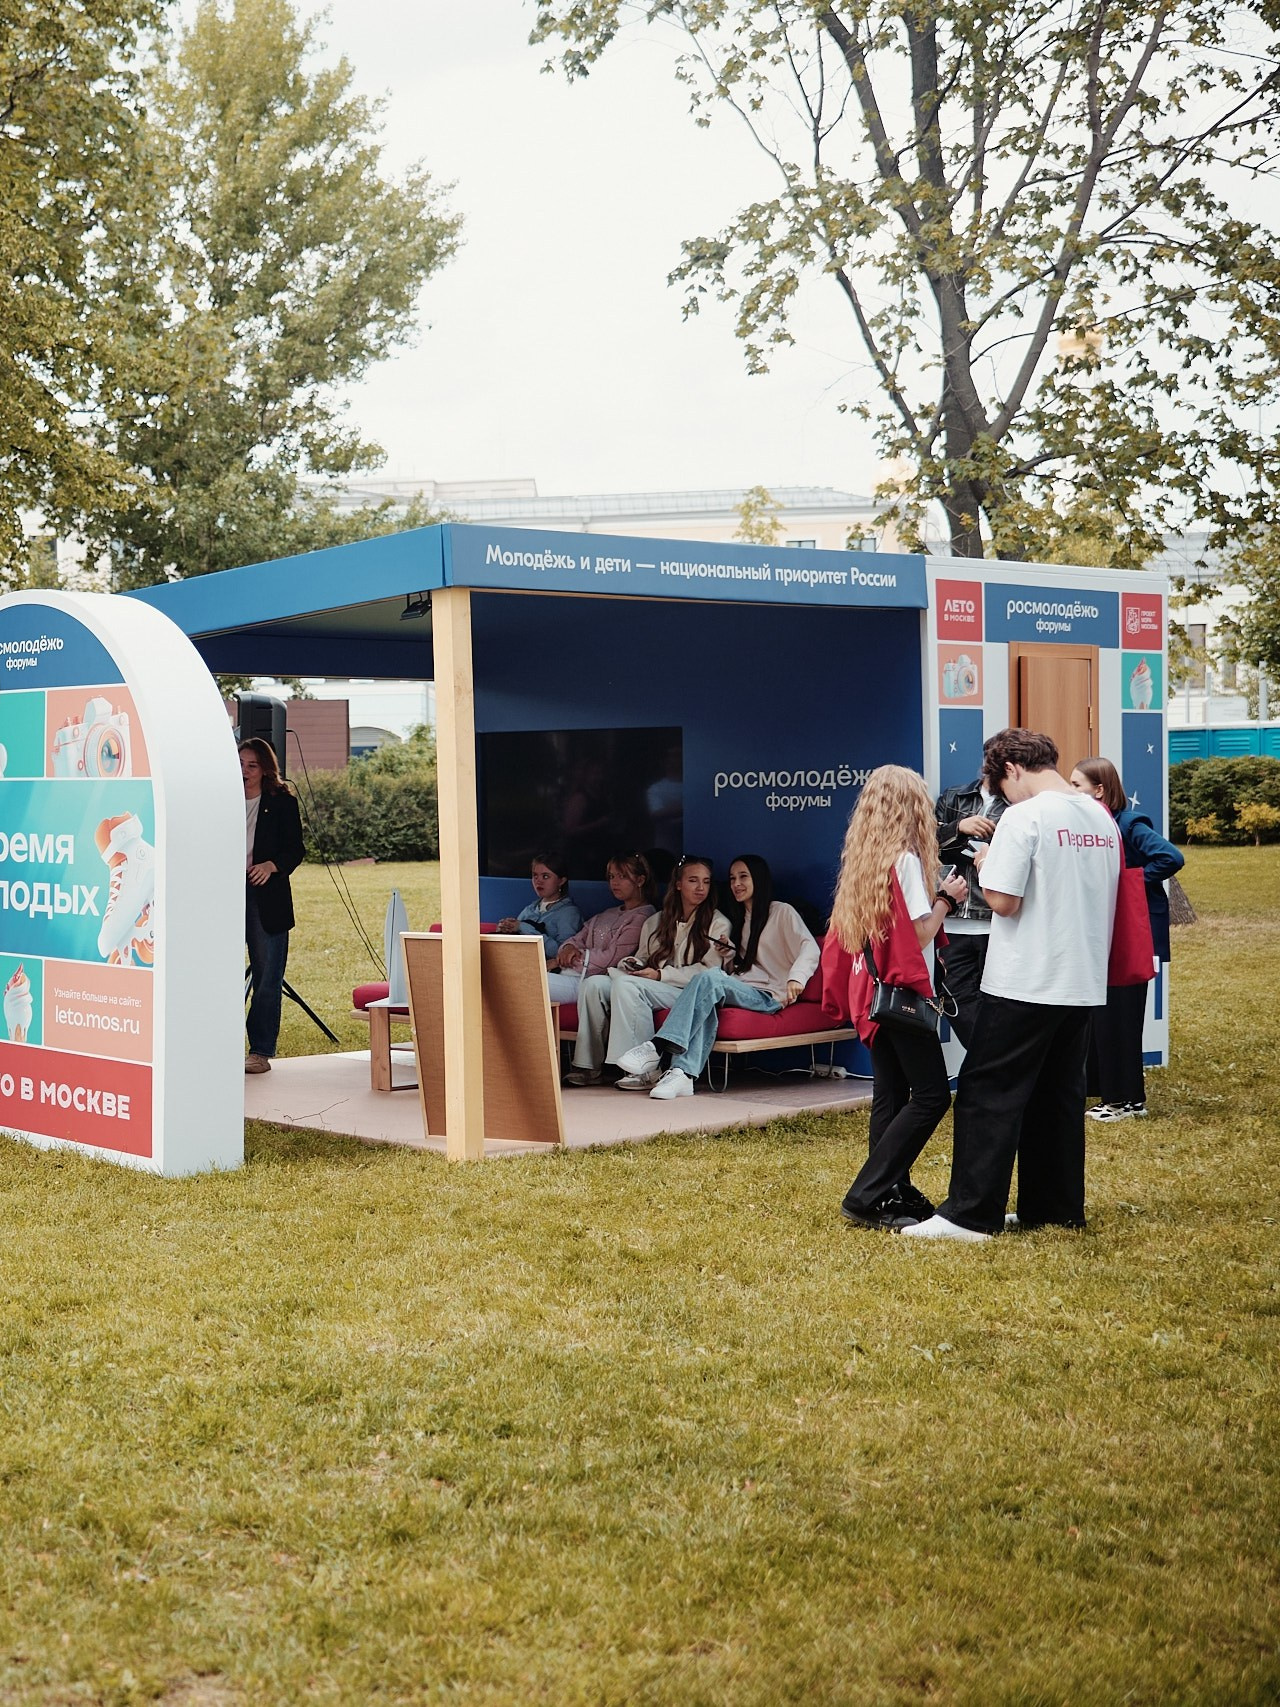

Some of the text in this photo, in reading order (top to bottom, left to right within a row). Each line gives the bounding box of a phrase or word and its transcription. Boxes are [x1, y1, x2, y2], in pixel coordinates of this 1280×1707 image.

[485, 544, 576, 571] Молодёжь
[580, 556, 591, 570] и
[594, 556, 632, 574] дети
[660, 560, 771, 581] национальный
[775, 567, 848, 588] приоритет
[850, 566, 897, 588] России
[944, 599, 975, 613] ЛЕТО
[1006, 599, 1099, 620] росмолодёжь
[950, 614, 975, 623] МОСКВЕ
[1035, 617, 1072, 634] форумы
[6, 657, 38, 671] форумы
[714, 764, 874, 797] росмолодёж
[765, 792, 831, 811] форумы
[1057, 828, 1114, 853] Первые
[53, 987, 142, 1008] Узнайте больше на сайте:
[55, 1005, 140, 1035] leto.mos.ru
[20, 1076, 34, 1101] В
[40, 1080, 131, 1120] МОСКВЕ
